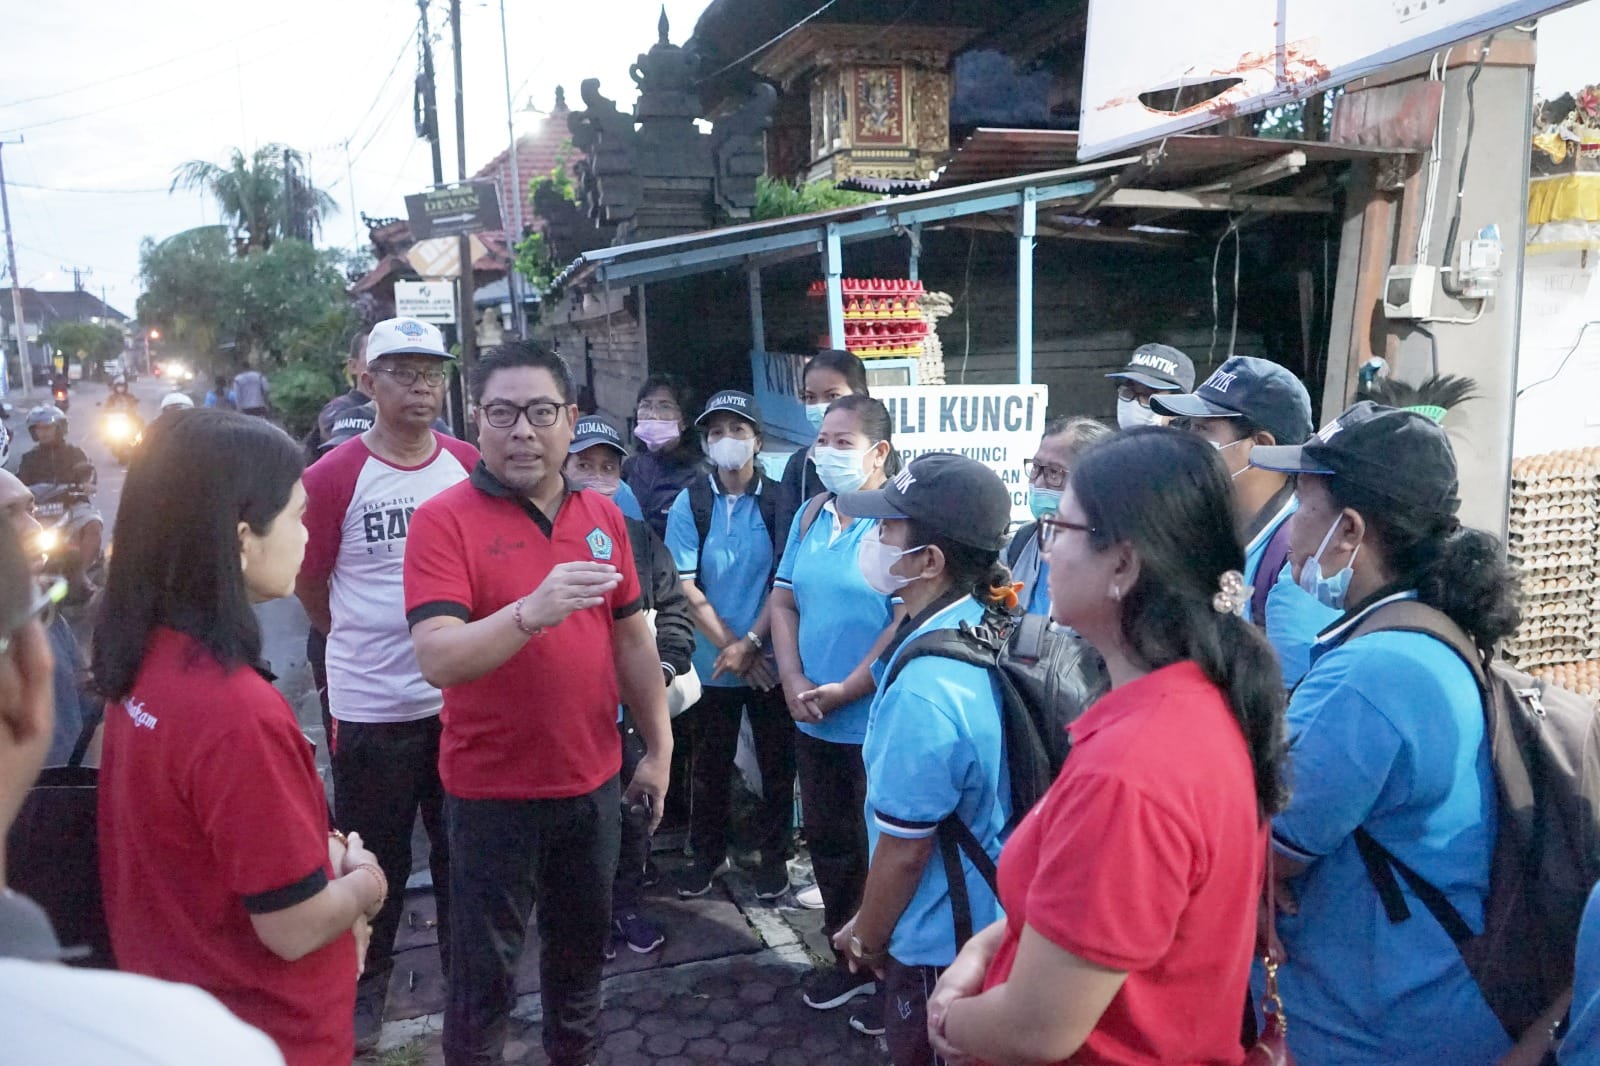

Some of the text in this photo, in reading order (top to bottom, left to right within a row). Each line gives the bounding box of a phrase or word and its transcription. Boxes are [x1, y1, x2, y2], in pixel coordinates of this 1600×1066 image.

[939, 395, 1034, 433] KUNCI
[577, 422, 620, 440] JUMANTIK
[961, 447, 1007, 462] KUNCI
